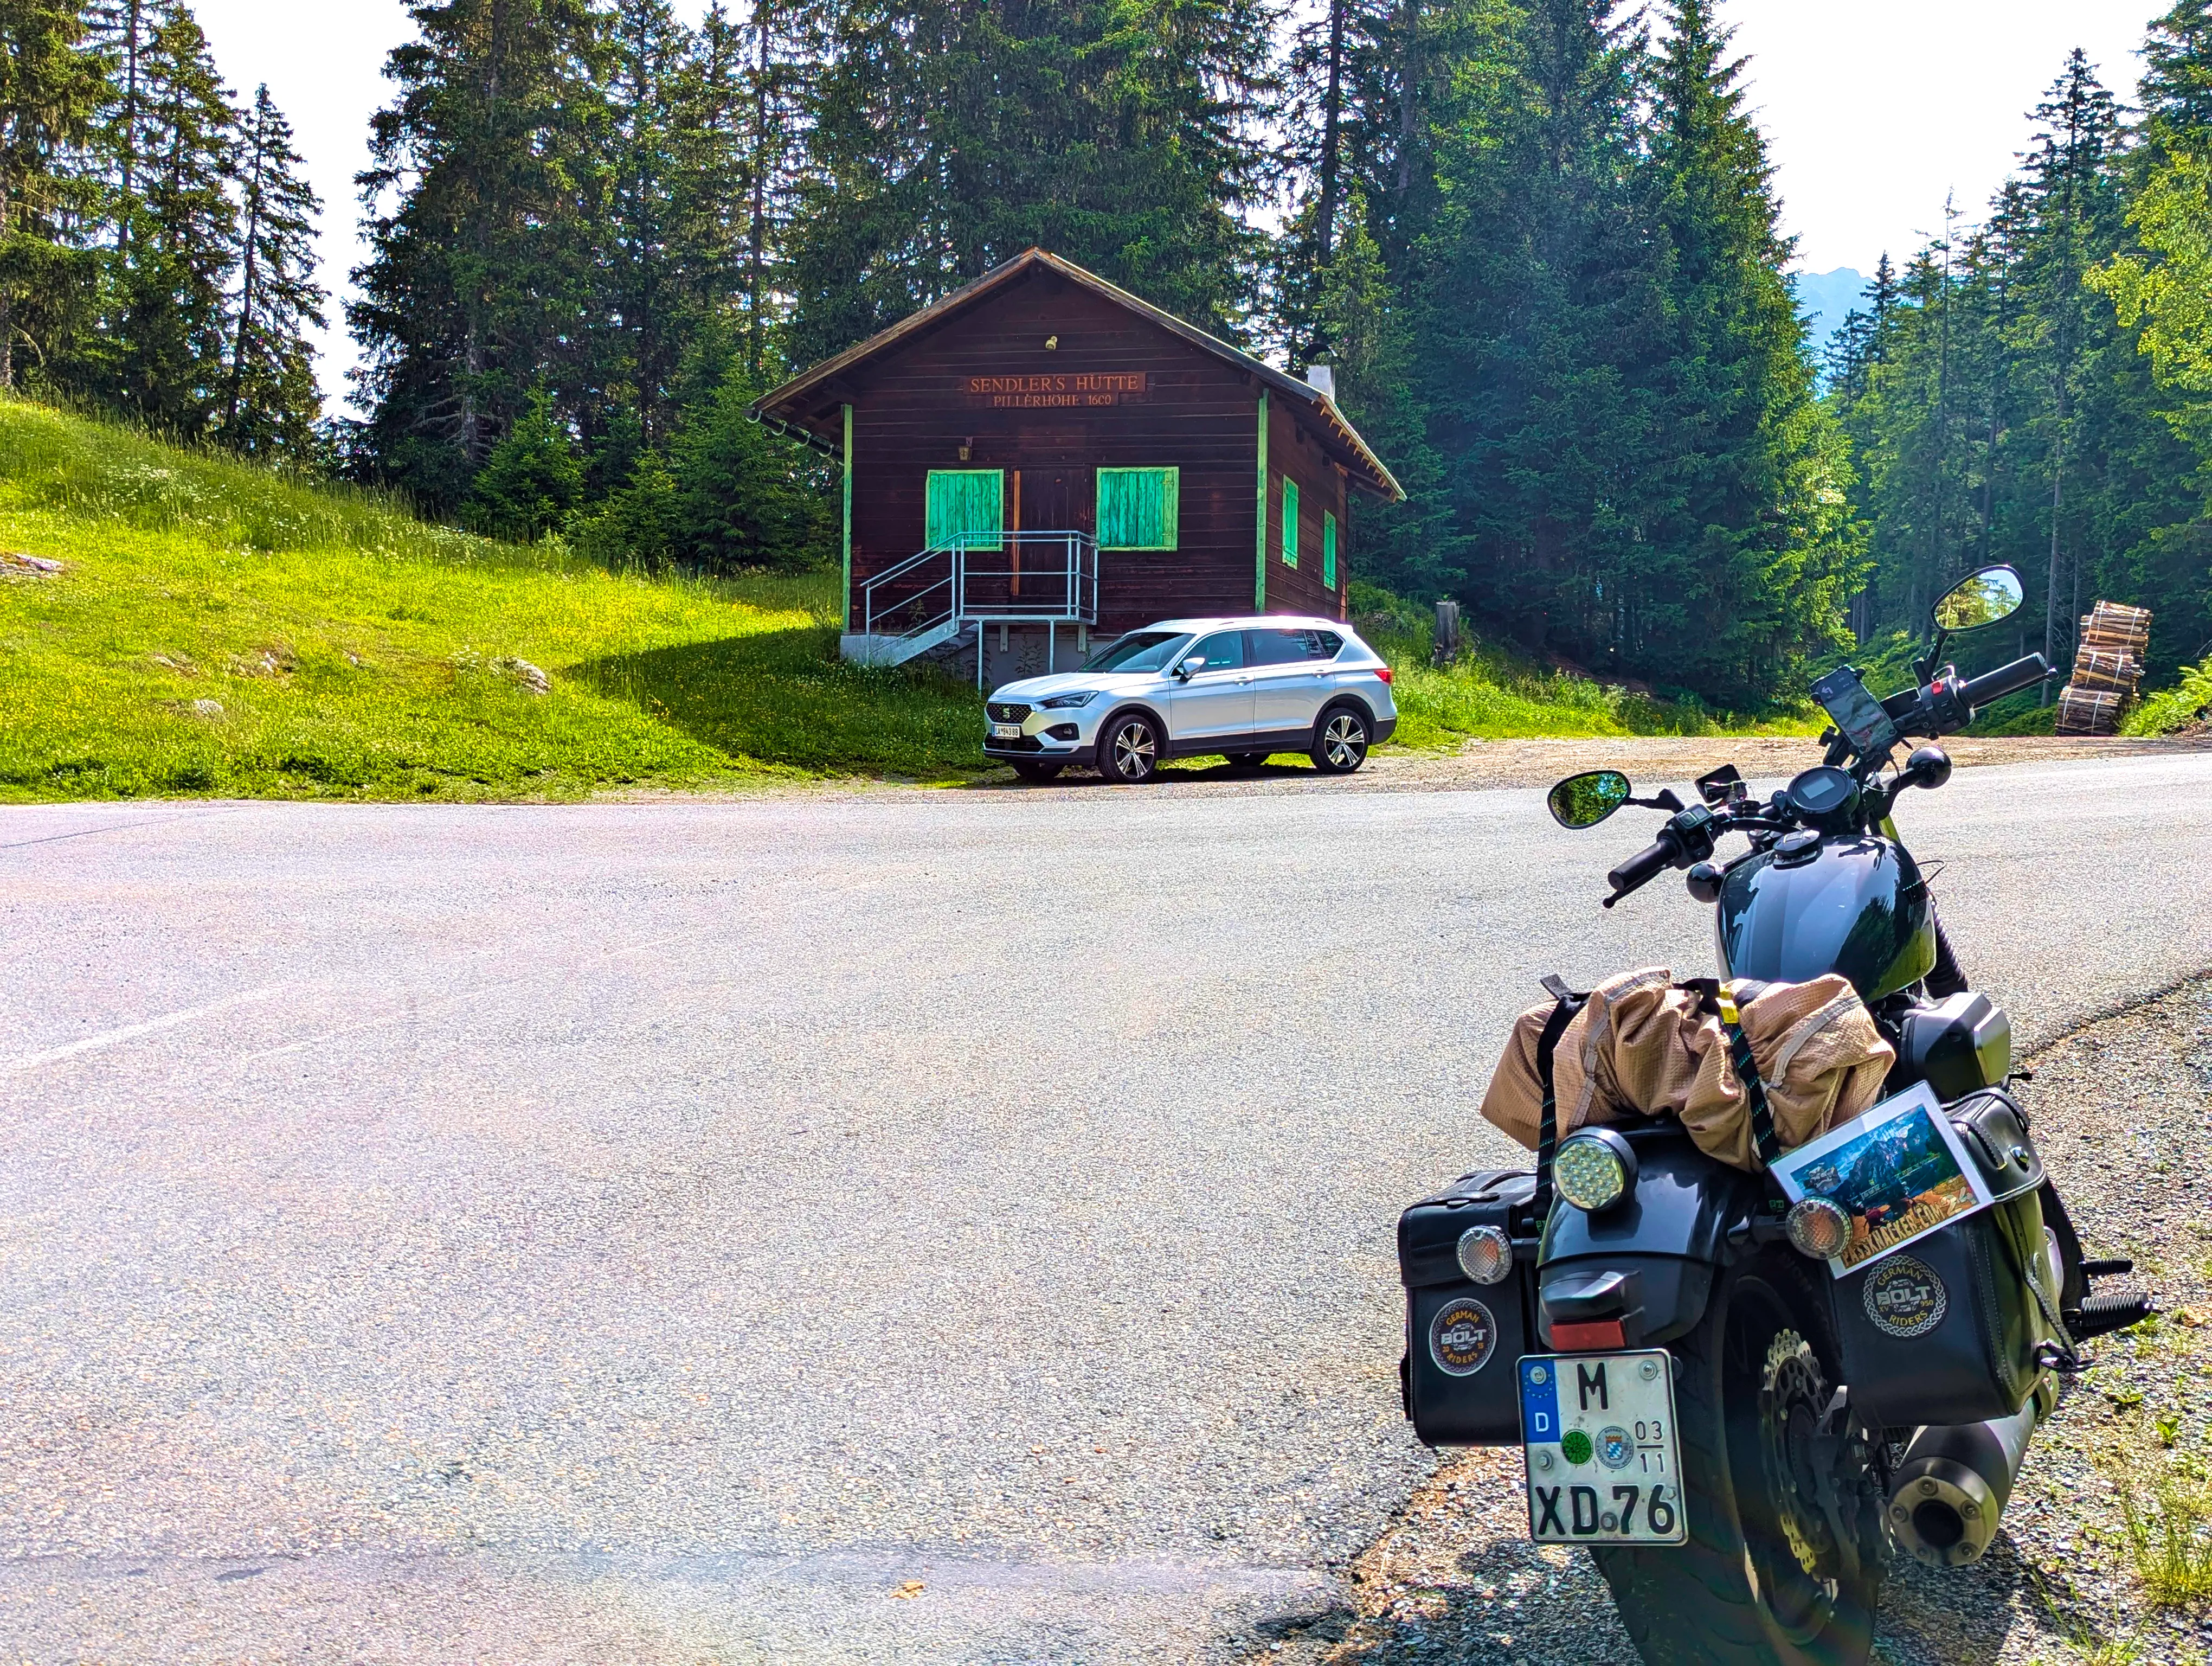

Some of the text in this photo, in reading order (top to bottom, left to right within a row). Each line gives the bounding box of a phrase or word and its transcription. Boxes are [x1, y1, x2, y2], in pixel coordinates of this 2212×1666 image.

[970, 374, 1139, 393] SENDLER'S HÜTTE
[993, 394, 1080, 407] PILLERHÖHE
[1877, 1266, 1923, 1286] GERMAN
[1876, 1286, 1930, 1305] BOLT
[1446, 1310, 1480, 1325] GERMAN
[1889, 1310, 1927, 1326] RIDERS
[1441, 1329, 1487, 1344] BOLT
[1447, 1351, 1477, 1363] RIDERS
[1577, 1362, 1609, 1411] M
[1535, 1412, 1549, 1432] D
[1634, 1420, 1663, 1441] 03
[1639, 1453, 1664, 1473] 11
[1535, 1484, 1675, 1535] XD 76
